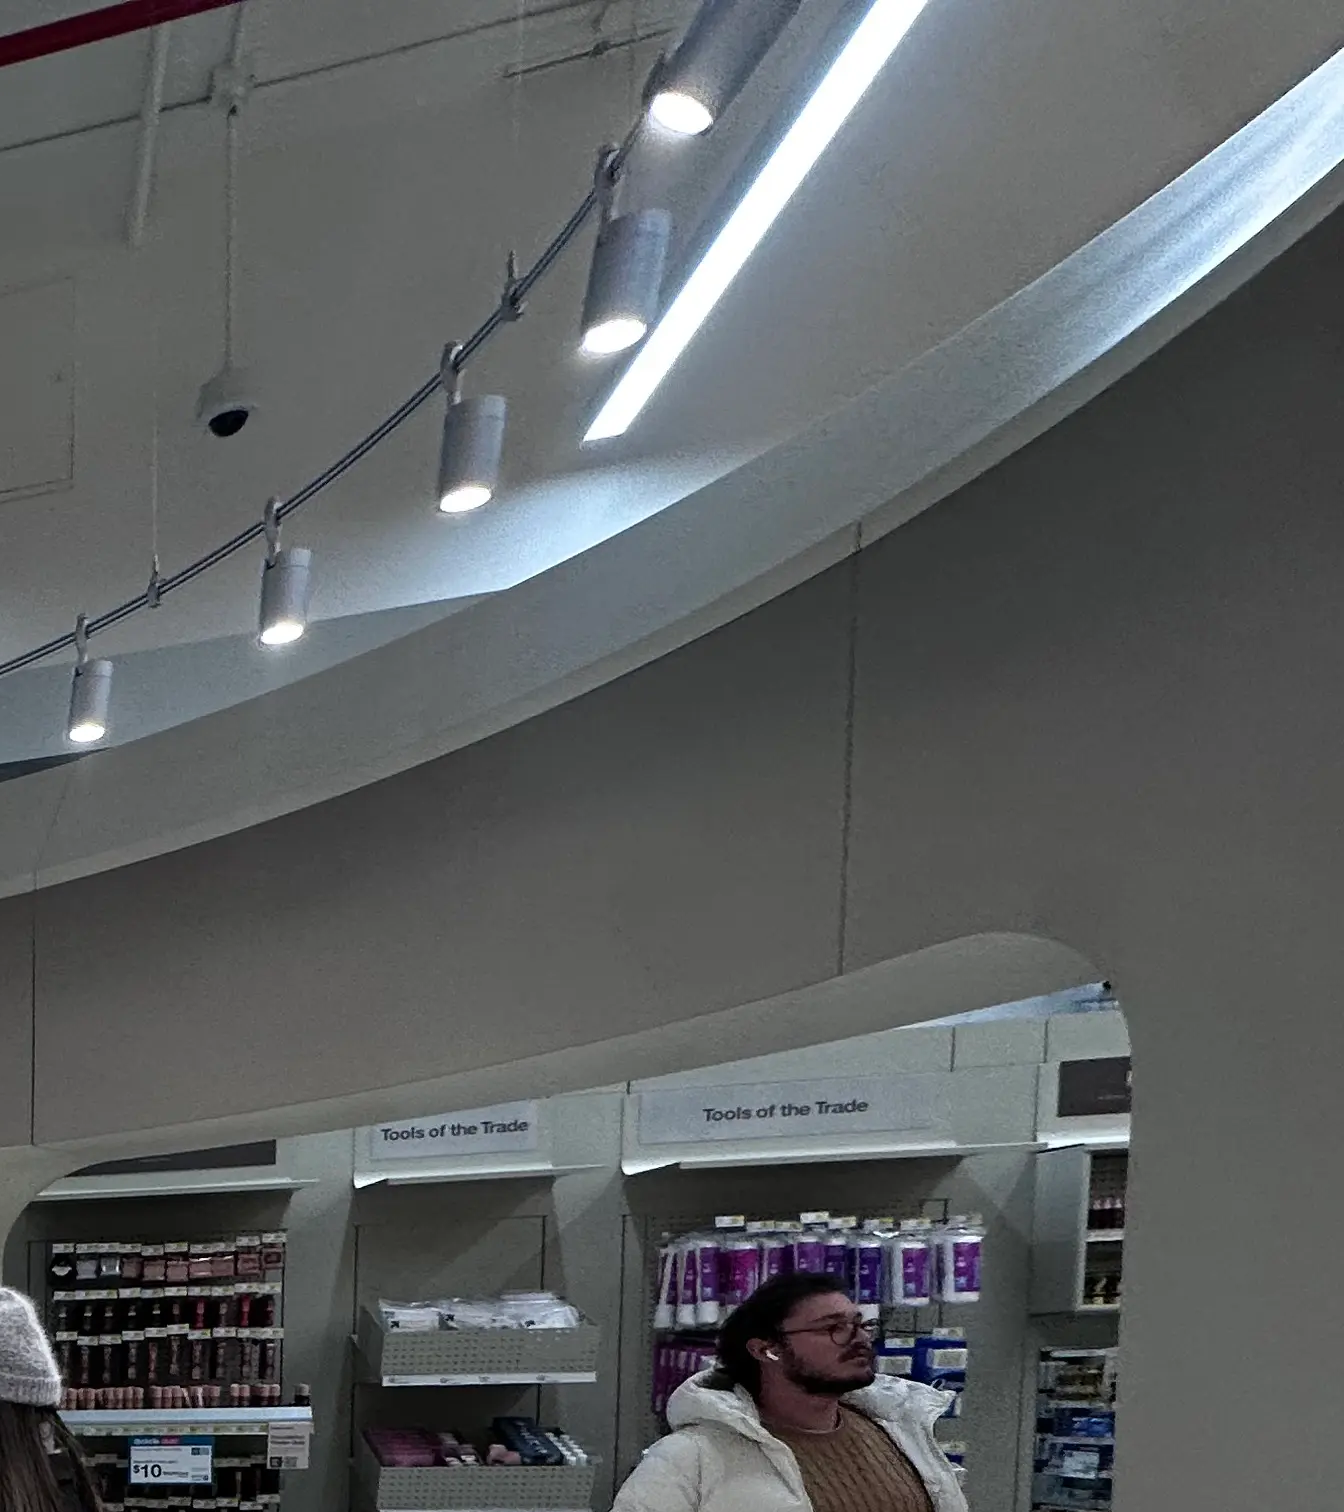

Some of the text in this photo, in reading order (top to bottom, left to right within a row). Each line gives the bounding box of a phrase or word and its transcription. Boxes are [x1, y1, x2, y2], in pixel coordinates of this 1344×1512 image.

[702, 1099, 870, 1122] Tools of the Trade
[380, 1119, 529, 1141] Tools of the Trade
[132, 1464, 162, 1479] $10
